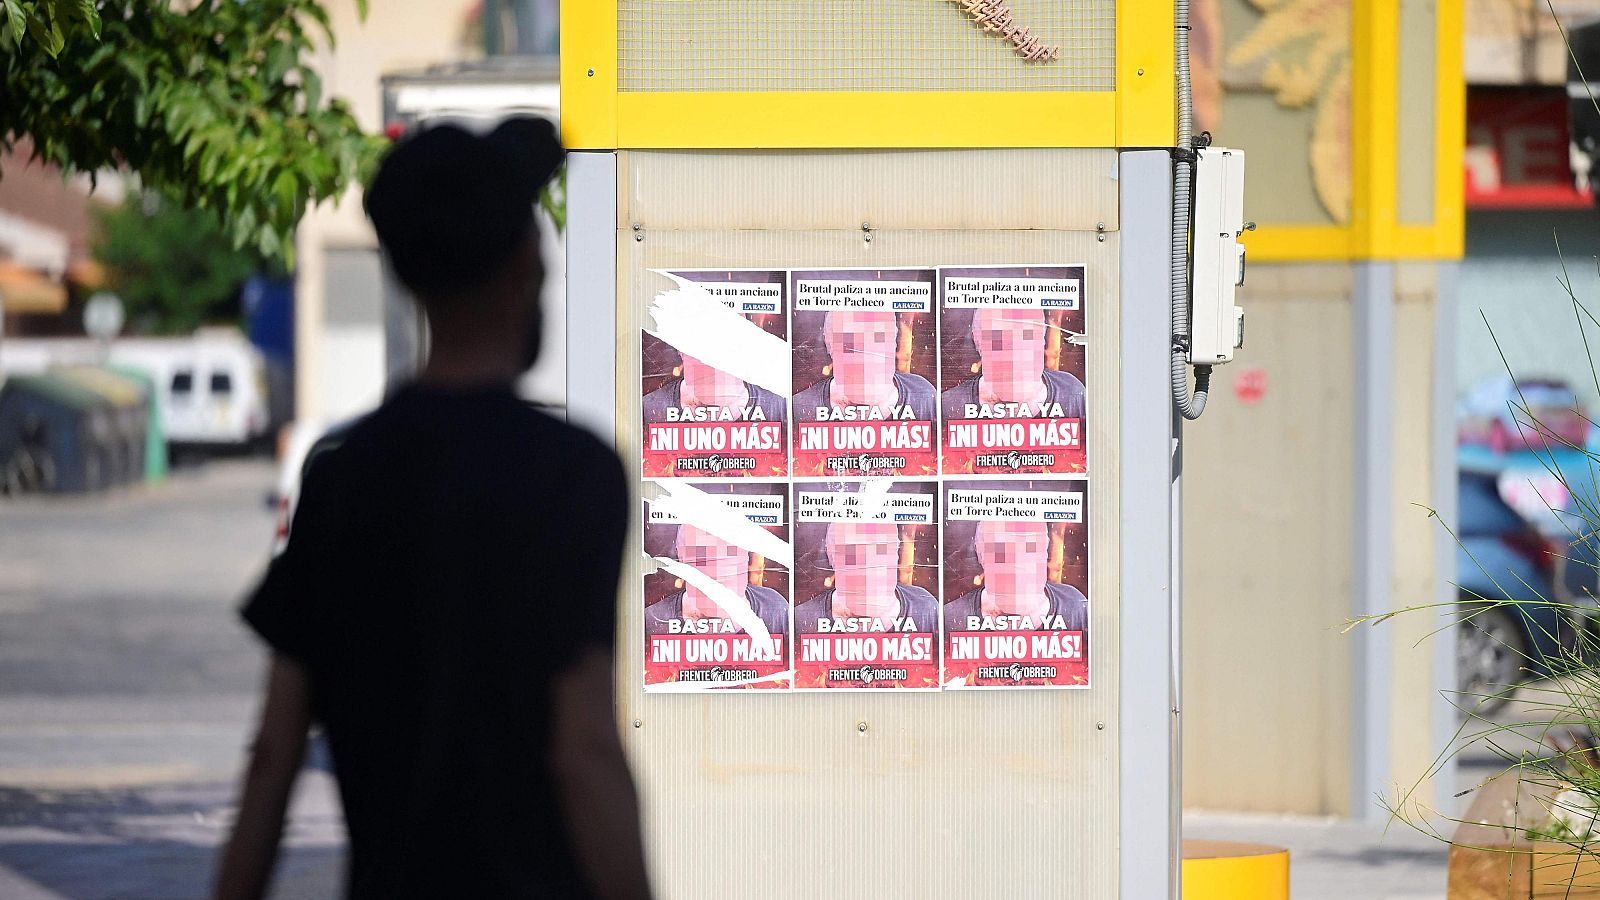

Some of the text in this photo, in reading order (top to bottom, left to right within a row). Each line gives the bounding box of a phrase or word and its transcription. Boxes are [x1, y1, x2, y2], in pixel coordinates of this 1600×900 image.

[724, 288, 737, 296] un
[740, 287, 779, 297] anciano
[800, 284, 831, 294] Brutal
[834, 285, 863, 296] paliza
[890, 286, 929, 295] anciano
[948, 281, 980, 291] Brutal
[982, 282, 1012, 294] paliza
[1038, 283, 1077, 293] anciano
[813, 296, 841, 306] Torre
[844, 297, 884, 307] Pacheco
[962, 294, 989, 304] Torre
[992, 295, 1033, 305] Pacheco
[666, 406, 766, 422] BASTA YA
[816, 405, 916, 421] BASTA YA
[965, 403, 1065, 418] BASTA YA
[651, 423, 780, 450] ¡NI UNO MÁS!
[801, 422, 930, 450] ¡NI UNO MÁS!
[950, 419, 1078, 448] ¡NI UNO MÁS!
[678, 458, 755, 469] FRENTE OBRERO
[828, 457, 905, 469] FRENTE OBRERO
[977, 455, 1054, 466] FRENTE OBRERO
[742, 499, 781, 509] anciano
[802, 496, 833, 506] Brutal
[892, 498, 931, 507] anciano
[952, 494, 983, 504] Brutal
[986, 495, 1015, 506] paliza
[1041, 496, 1080, 506] anciano
[965, 506, 993, 516] Torre
[996, 507, 1036, 517] Pacheco
[668, 619, 736, 634] BASTA
[818, 617, 918, 633] BASTA YA
[967, 615, 1067, 631] BASTA YA
[653, 640, 681, 662] ¡NI
[686, 639, 728, 662] UNO
[802, 633, 931, 662] ¡NI UNO MÁS!
[952, 632, 1081, 660] ¡NI UNO MÁS!
[680, 670, 757, 681] FRENTE OBRERO
[830, 669, 907, 680] FRENTE OBRERO
[979, 667, 1056, 678] FRENTE OBRERO
